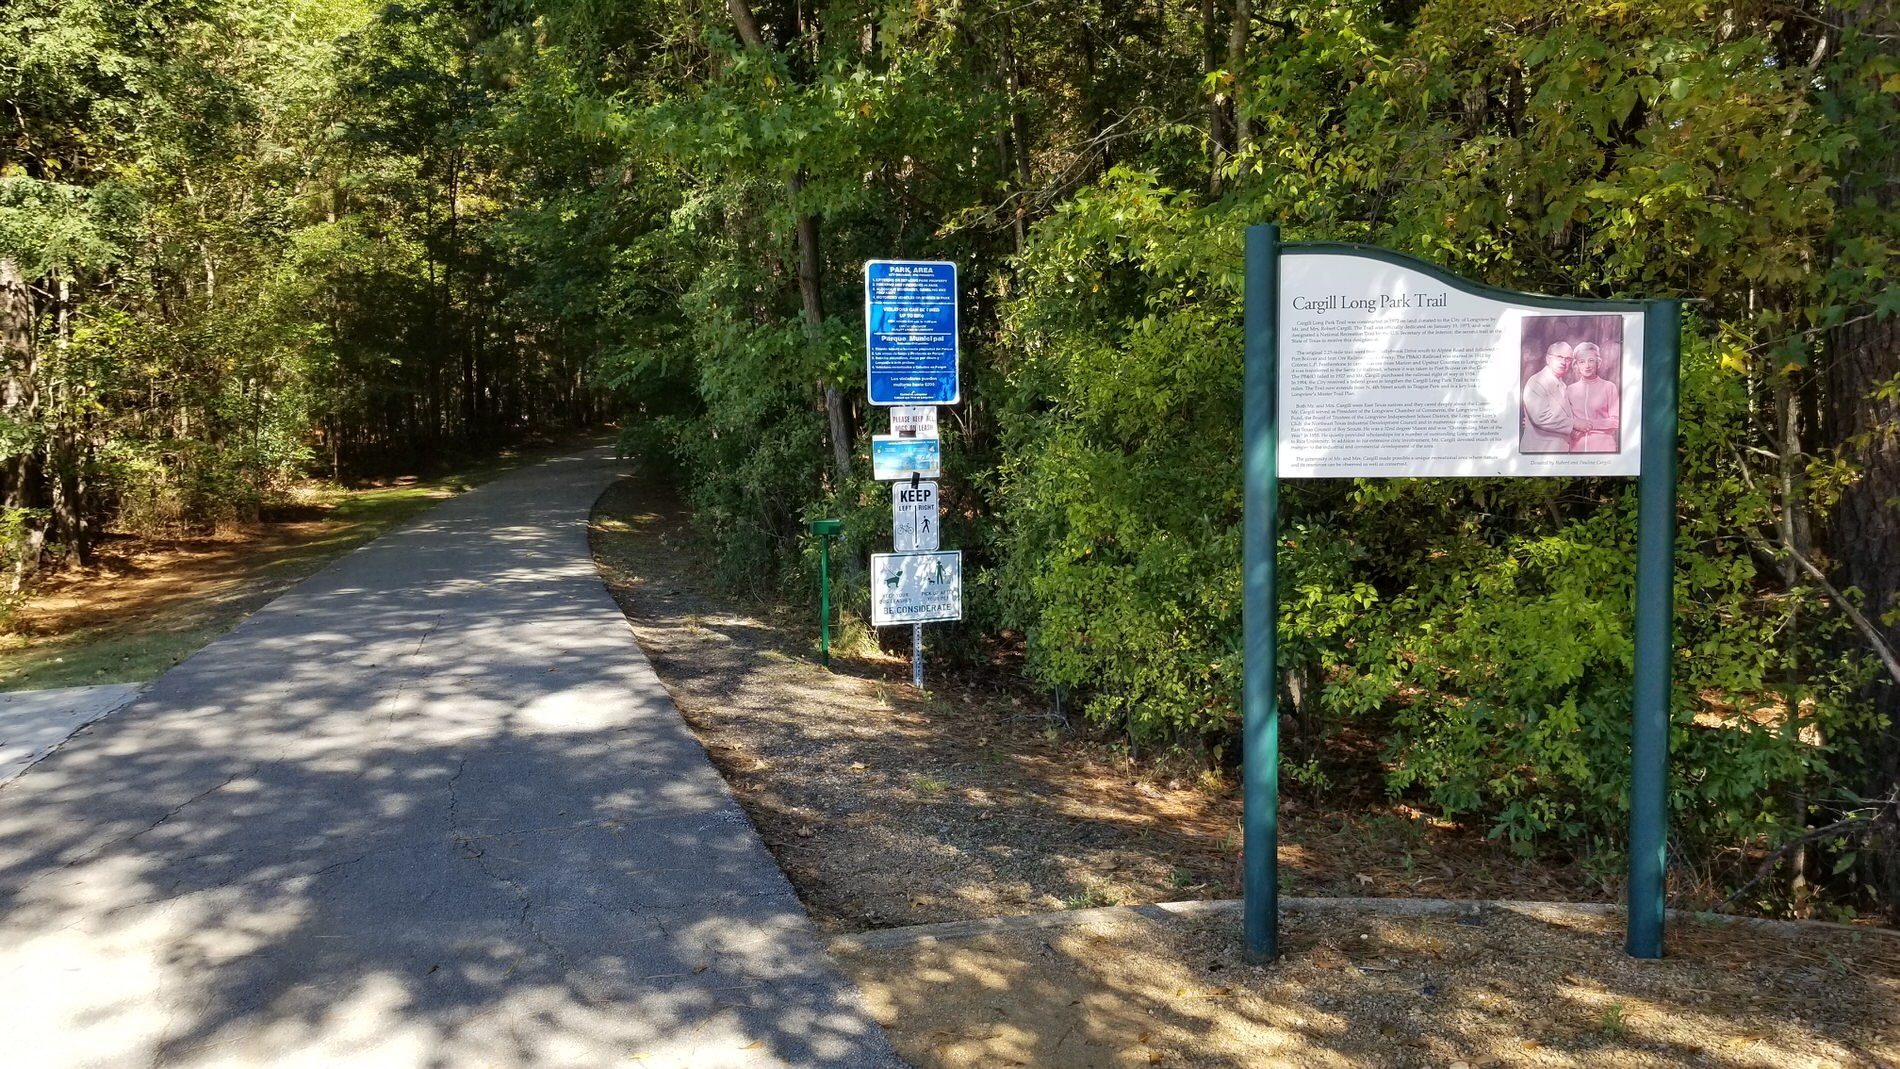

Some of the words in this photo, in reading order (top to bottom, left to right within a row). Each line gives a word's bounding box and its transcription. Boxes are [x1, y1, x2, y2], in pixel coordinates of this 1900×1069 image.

[1293, 296, 1337, 314] Cargill
[1341, 296, 1376, 313] Long
[1380, 294, 1410, 308] Park
[1414, 293, 1448, 308] Trail
[900, 490, 931, 502] KEEP
[896, 603, 951, 614] CONSIDERATE
